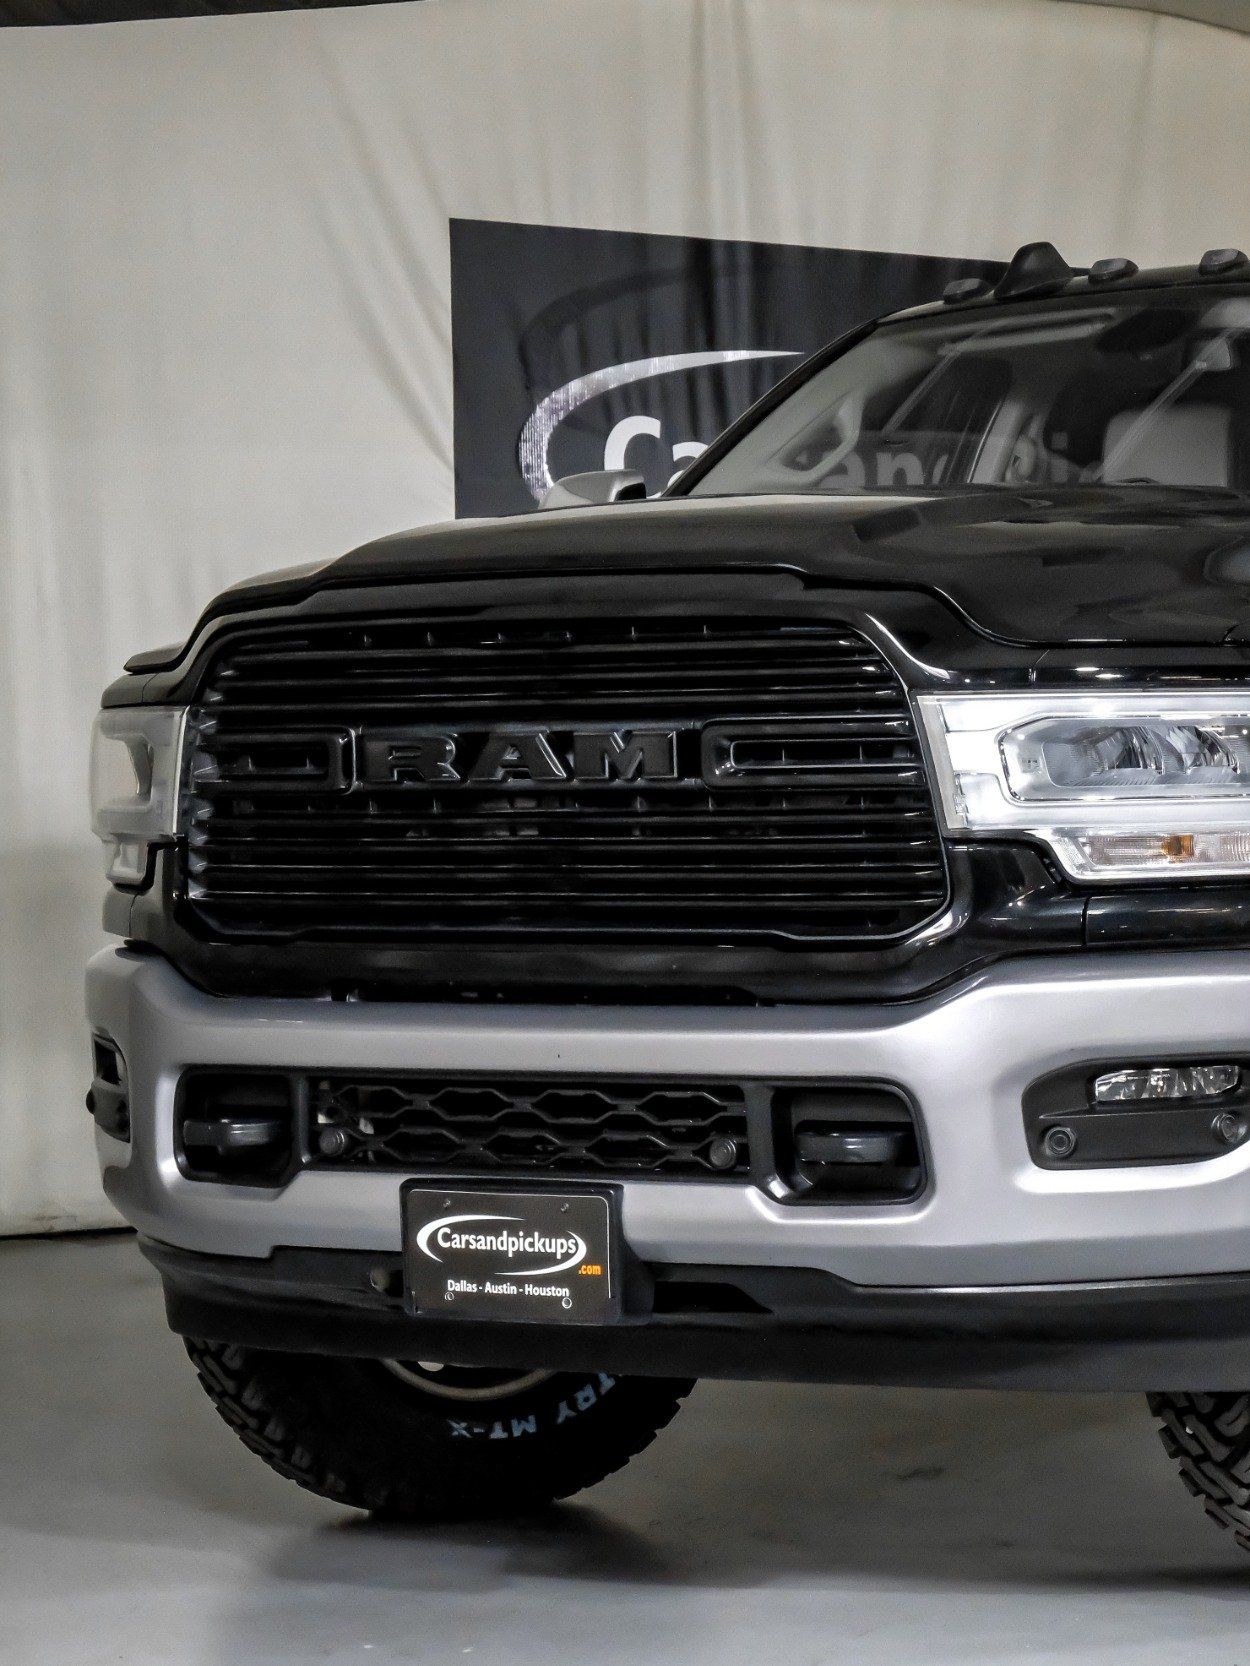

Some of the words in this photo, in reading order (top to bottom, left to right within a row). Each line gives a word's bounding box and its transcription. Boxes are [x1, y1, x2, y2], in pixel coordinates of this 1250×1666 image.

[358, 729, 679, 783] RAM
[437, 1227, 578, 1260] Carsandpickups
[578, 1264, 602, 1276] .com
[447, 1280, 477, 1293] Dallas
[484, 1281, 517, 1295] Austin
[524, 1283, 570, 1297] Houston
